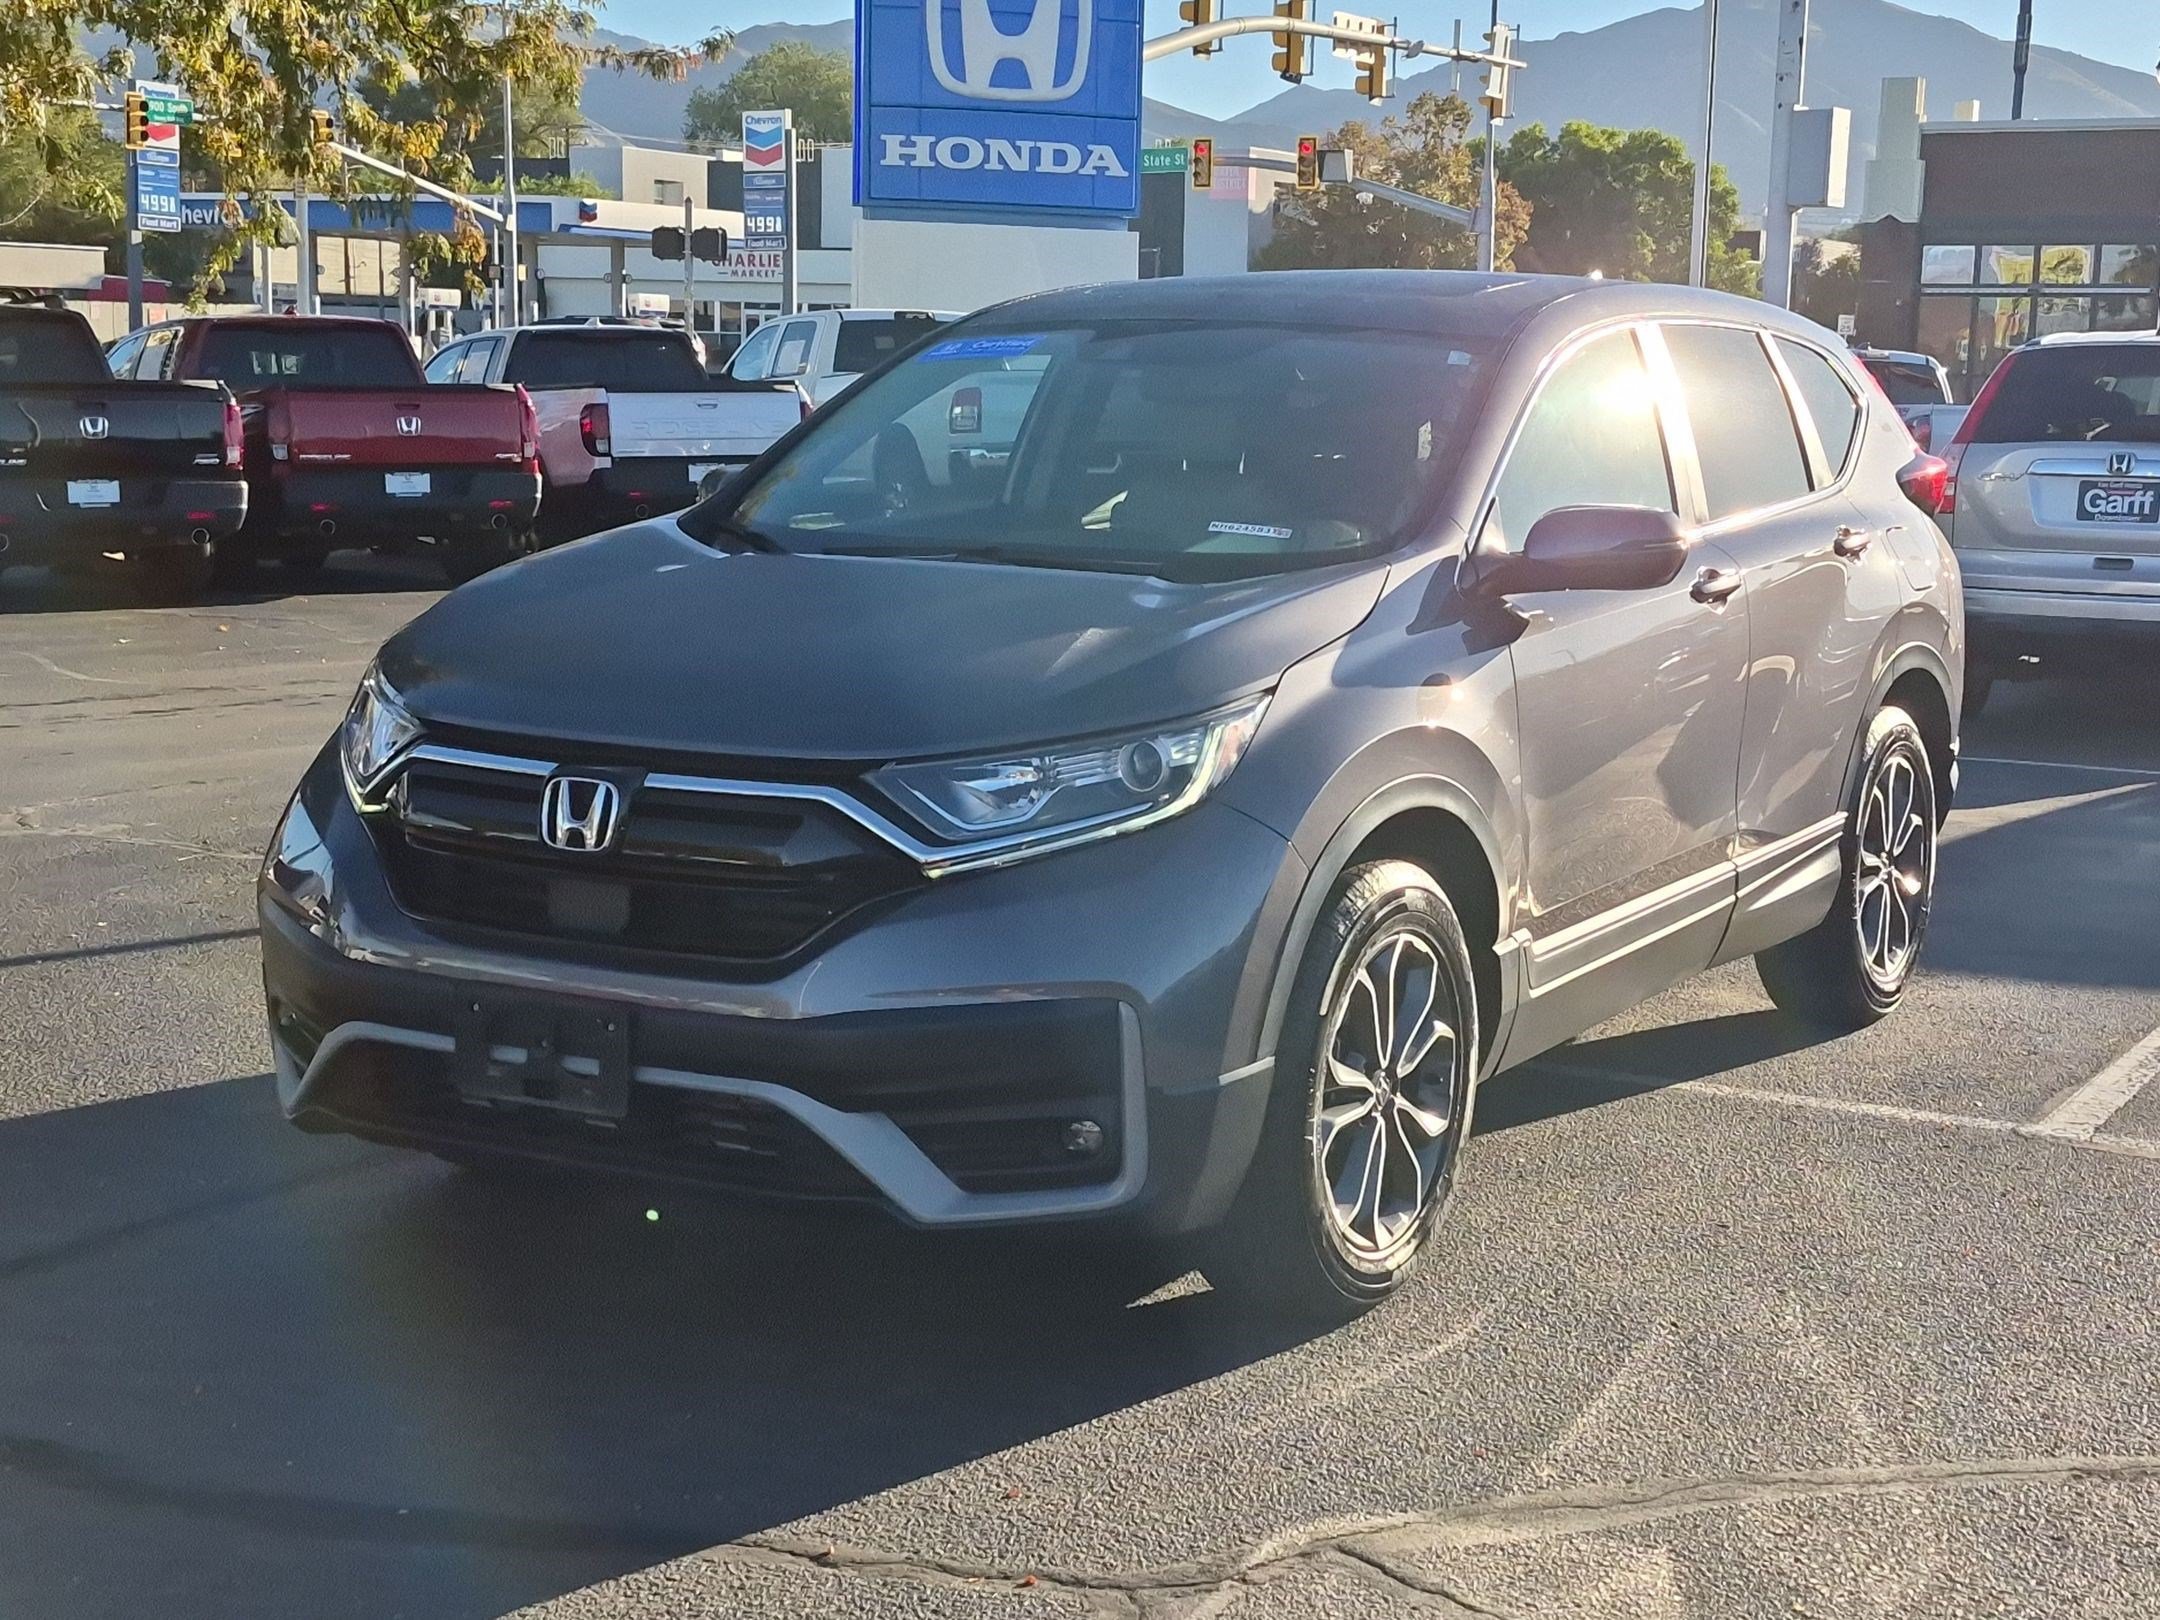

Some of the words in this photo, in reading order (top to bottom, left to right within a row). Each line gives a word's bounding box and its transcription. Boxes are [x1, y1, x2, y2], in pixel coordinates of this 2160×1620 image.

[744, 115, 782, 126] Chevron
[879, 133, 1129, 178] HONDA
[1143, 154, 1171, 167] State
[1175, 153, 1186, 165] St
[730, 269, 776, 278] MARKET
[2083, 488, 2155, 515] Garff
